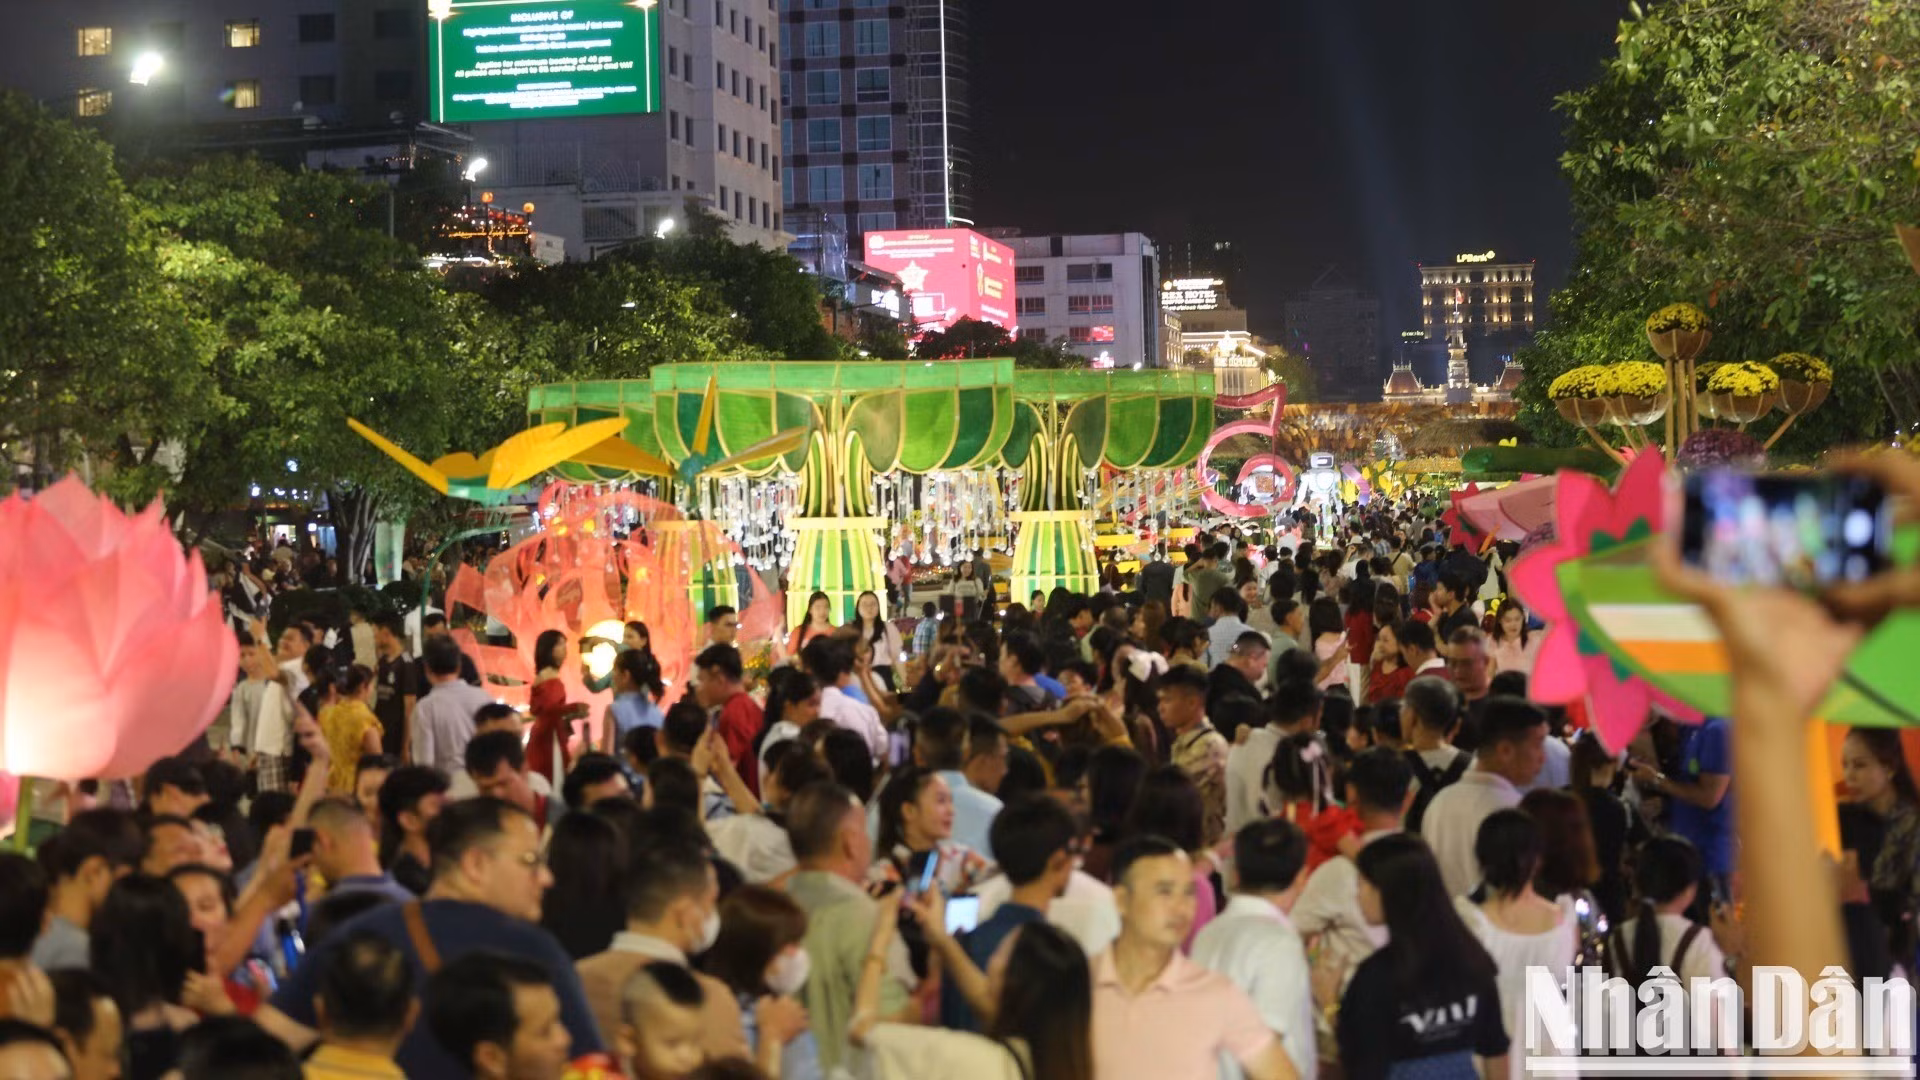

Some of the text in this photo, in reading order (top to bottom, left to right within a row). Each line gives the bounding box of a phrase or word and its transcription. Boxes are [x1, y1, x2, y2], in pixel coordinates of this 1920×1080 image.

[511, 10, 574, 22] INCLUSIVE OF
[465, 69, 488, 78] prices
[488, 68, 501, 76] are
[502, 67, 528, 76] subject
[549, 64, 576, 73] service
[577, 63, 603, 72] charge
[604, 62, 619, 70] and
[619, 61, 633, 69] VAT
[476, 61, 502, 70] Applies
[502, 60, 513, 68] for
[514, 59, 548, 67] minimum
[549, 57, 578, 66] booking
[1456, 252, 1487, 263] LPBank
[1161, 290, 1216, 299] REX HOTEL
